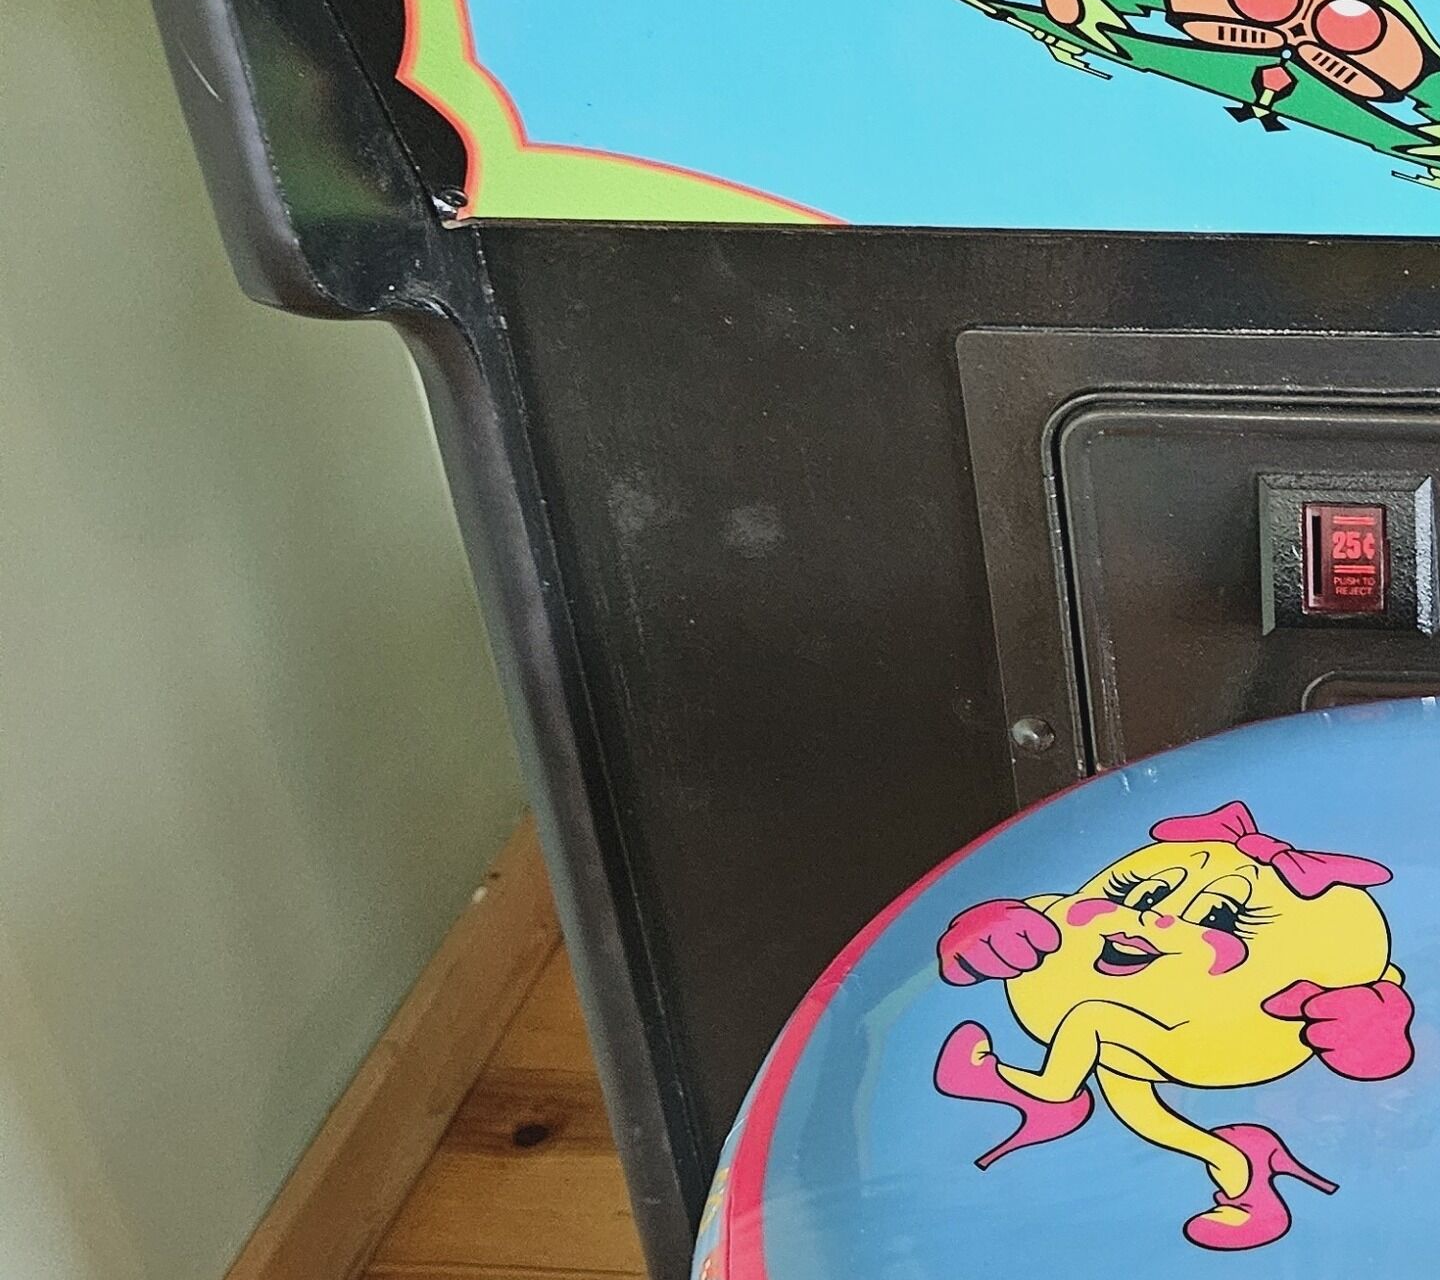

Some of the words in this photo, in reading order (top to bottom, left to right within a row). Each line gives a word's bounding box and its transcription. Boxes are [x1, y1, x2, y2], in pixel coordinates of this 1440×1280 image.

[1332, 531, 1375, 560] 25¢
[1363, 577, 1376, 586] TO
[1336, 586, 1372, 595] REJECT
